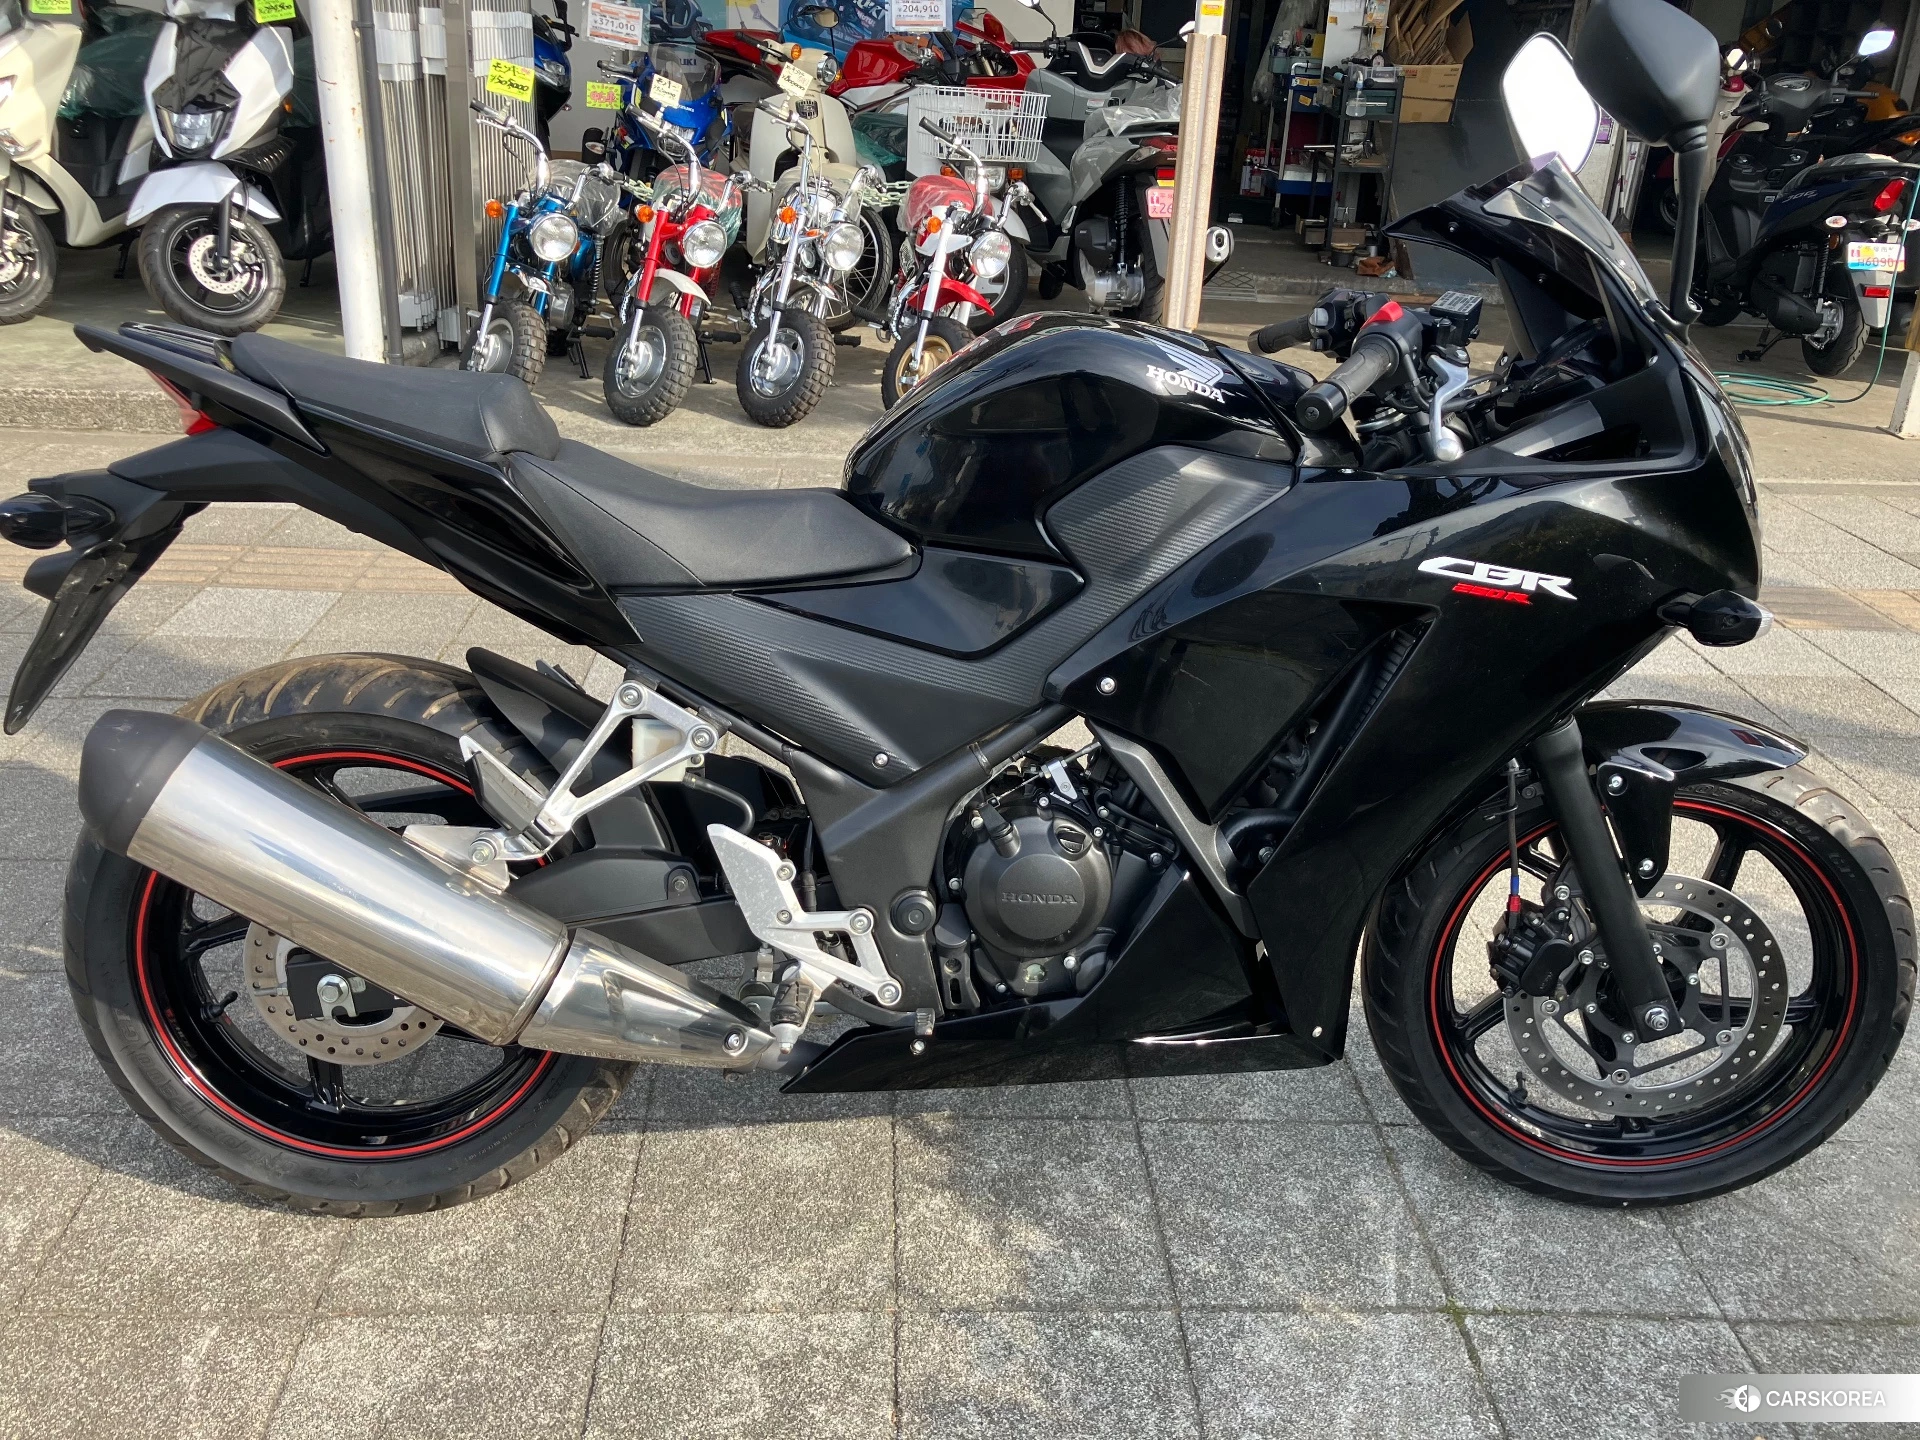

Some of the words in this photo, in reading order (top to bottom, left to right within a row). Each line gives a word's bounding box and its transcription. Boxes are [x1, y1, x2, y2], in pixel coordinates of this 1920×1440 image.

[898, 4, 939, 13] ¥204,910
[594, 17, 636, 32] ¥371,010
[1146, 364, 1226, 404] HONDA
[1418, 556, 1578, 600] CBR
[1451, 582, 1533, 605] 250R
[1001, 892, 1078, 904] HONDA
